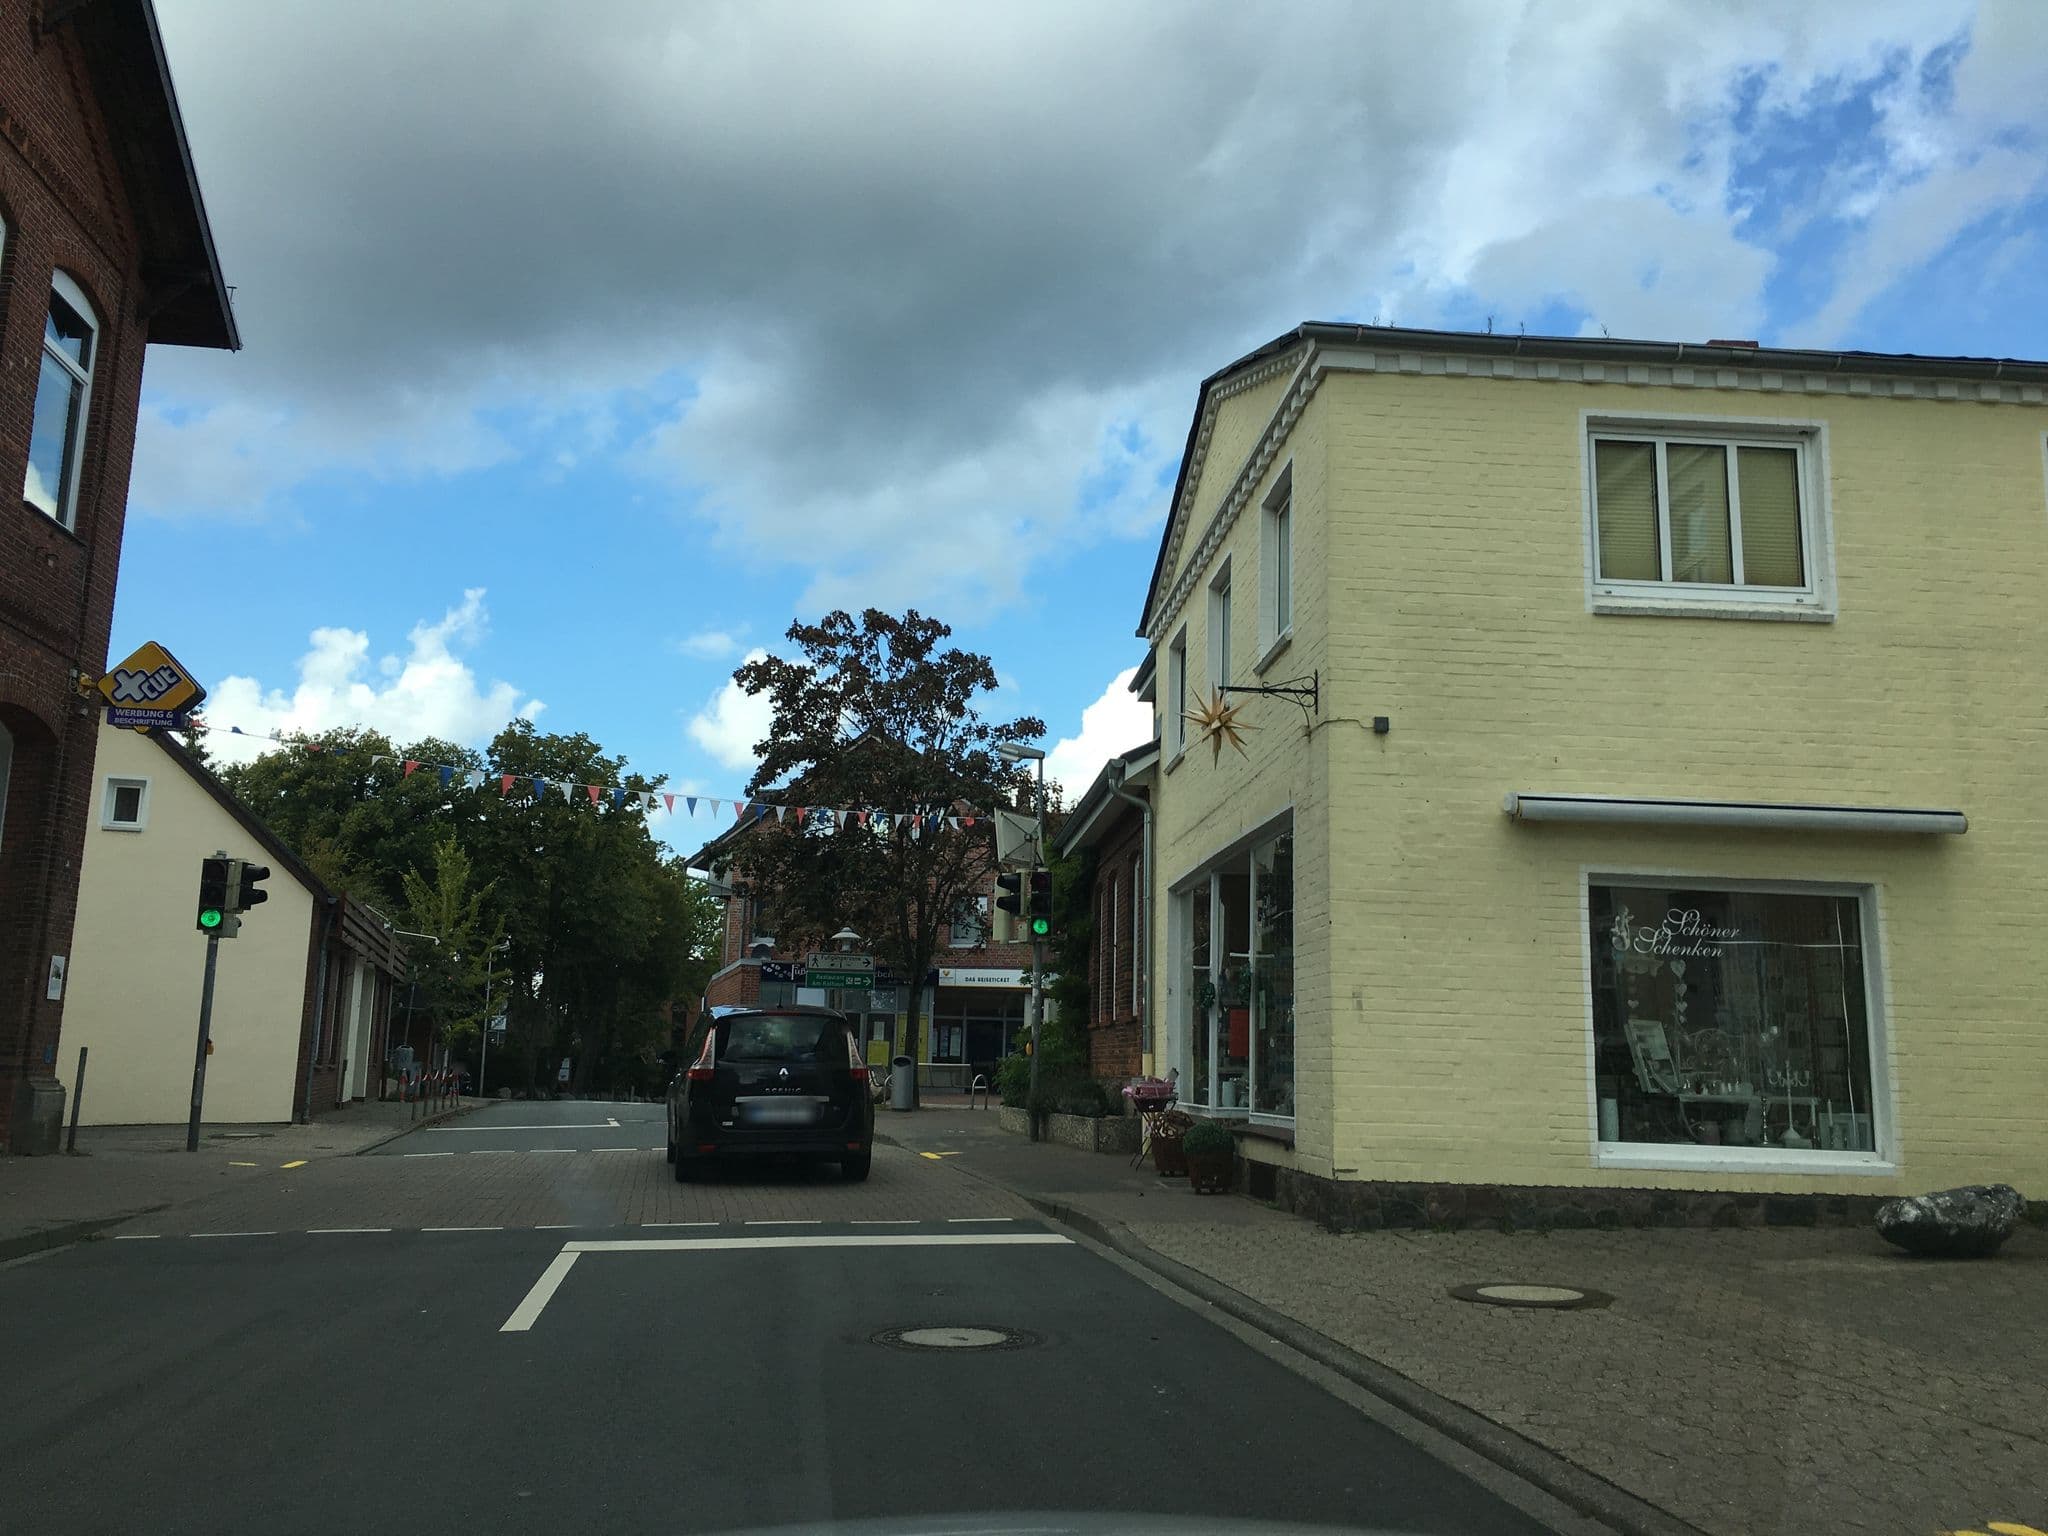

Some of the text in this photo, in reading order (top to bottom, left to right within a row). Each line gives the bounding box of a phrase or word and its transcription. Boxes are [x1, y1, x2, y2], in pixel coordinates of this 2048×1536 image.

[114, 717, 173, 726] BESCHRIFTUNG
[115, 708, 174, 719] WERBUNG &
[1662, 908, 1740, 938] Schöner
[1633, 926, 1725, 957] Schenken
